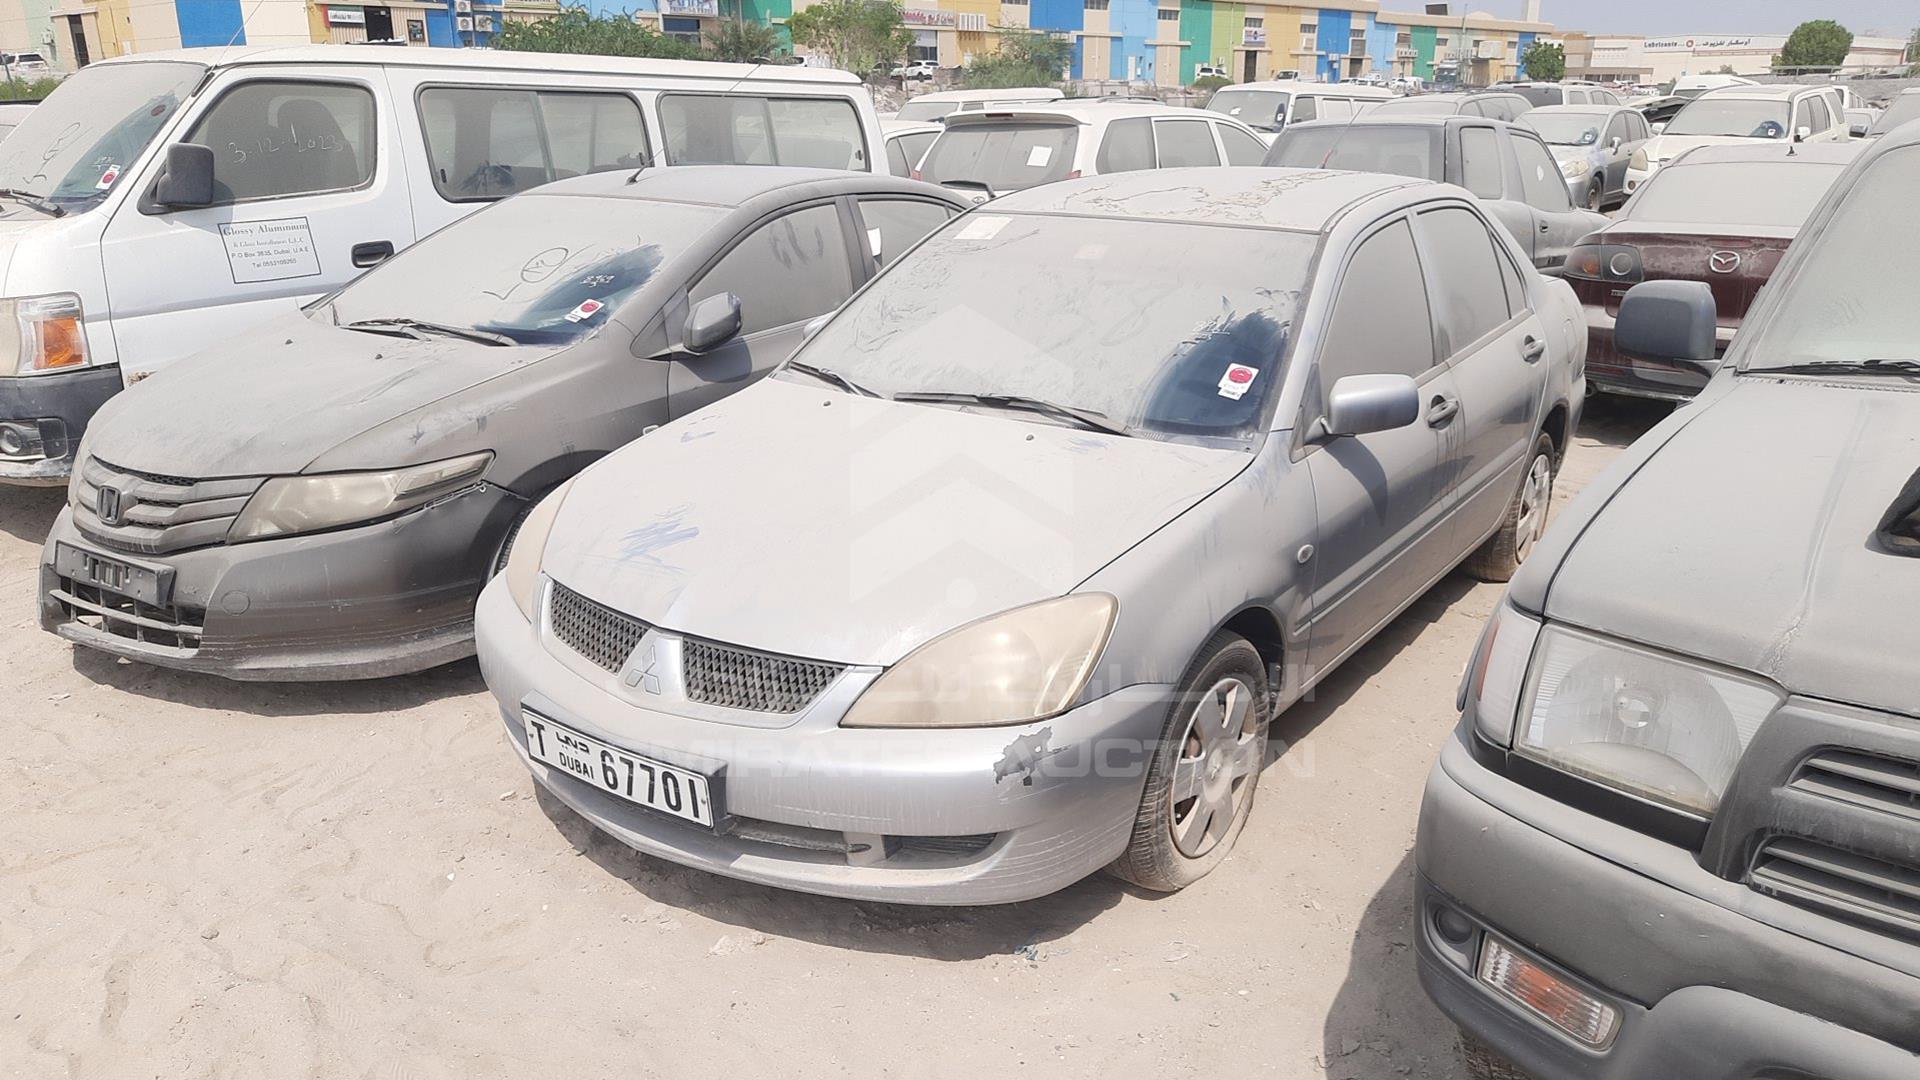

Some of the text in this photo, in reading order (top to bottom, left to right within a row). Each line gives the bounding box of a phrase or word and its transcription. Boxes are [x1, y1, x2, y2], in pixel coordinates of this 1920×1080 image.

[223, 226, 254, 237] Glossy
[530, 720, 546, 757] T
[555, 730, 590, 755] دبي
[558, 751, 595, 780] DUBAI
[600, 749, 700, 819] 67701
